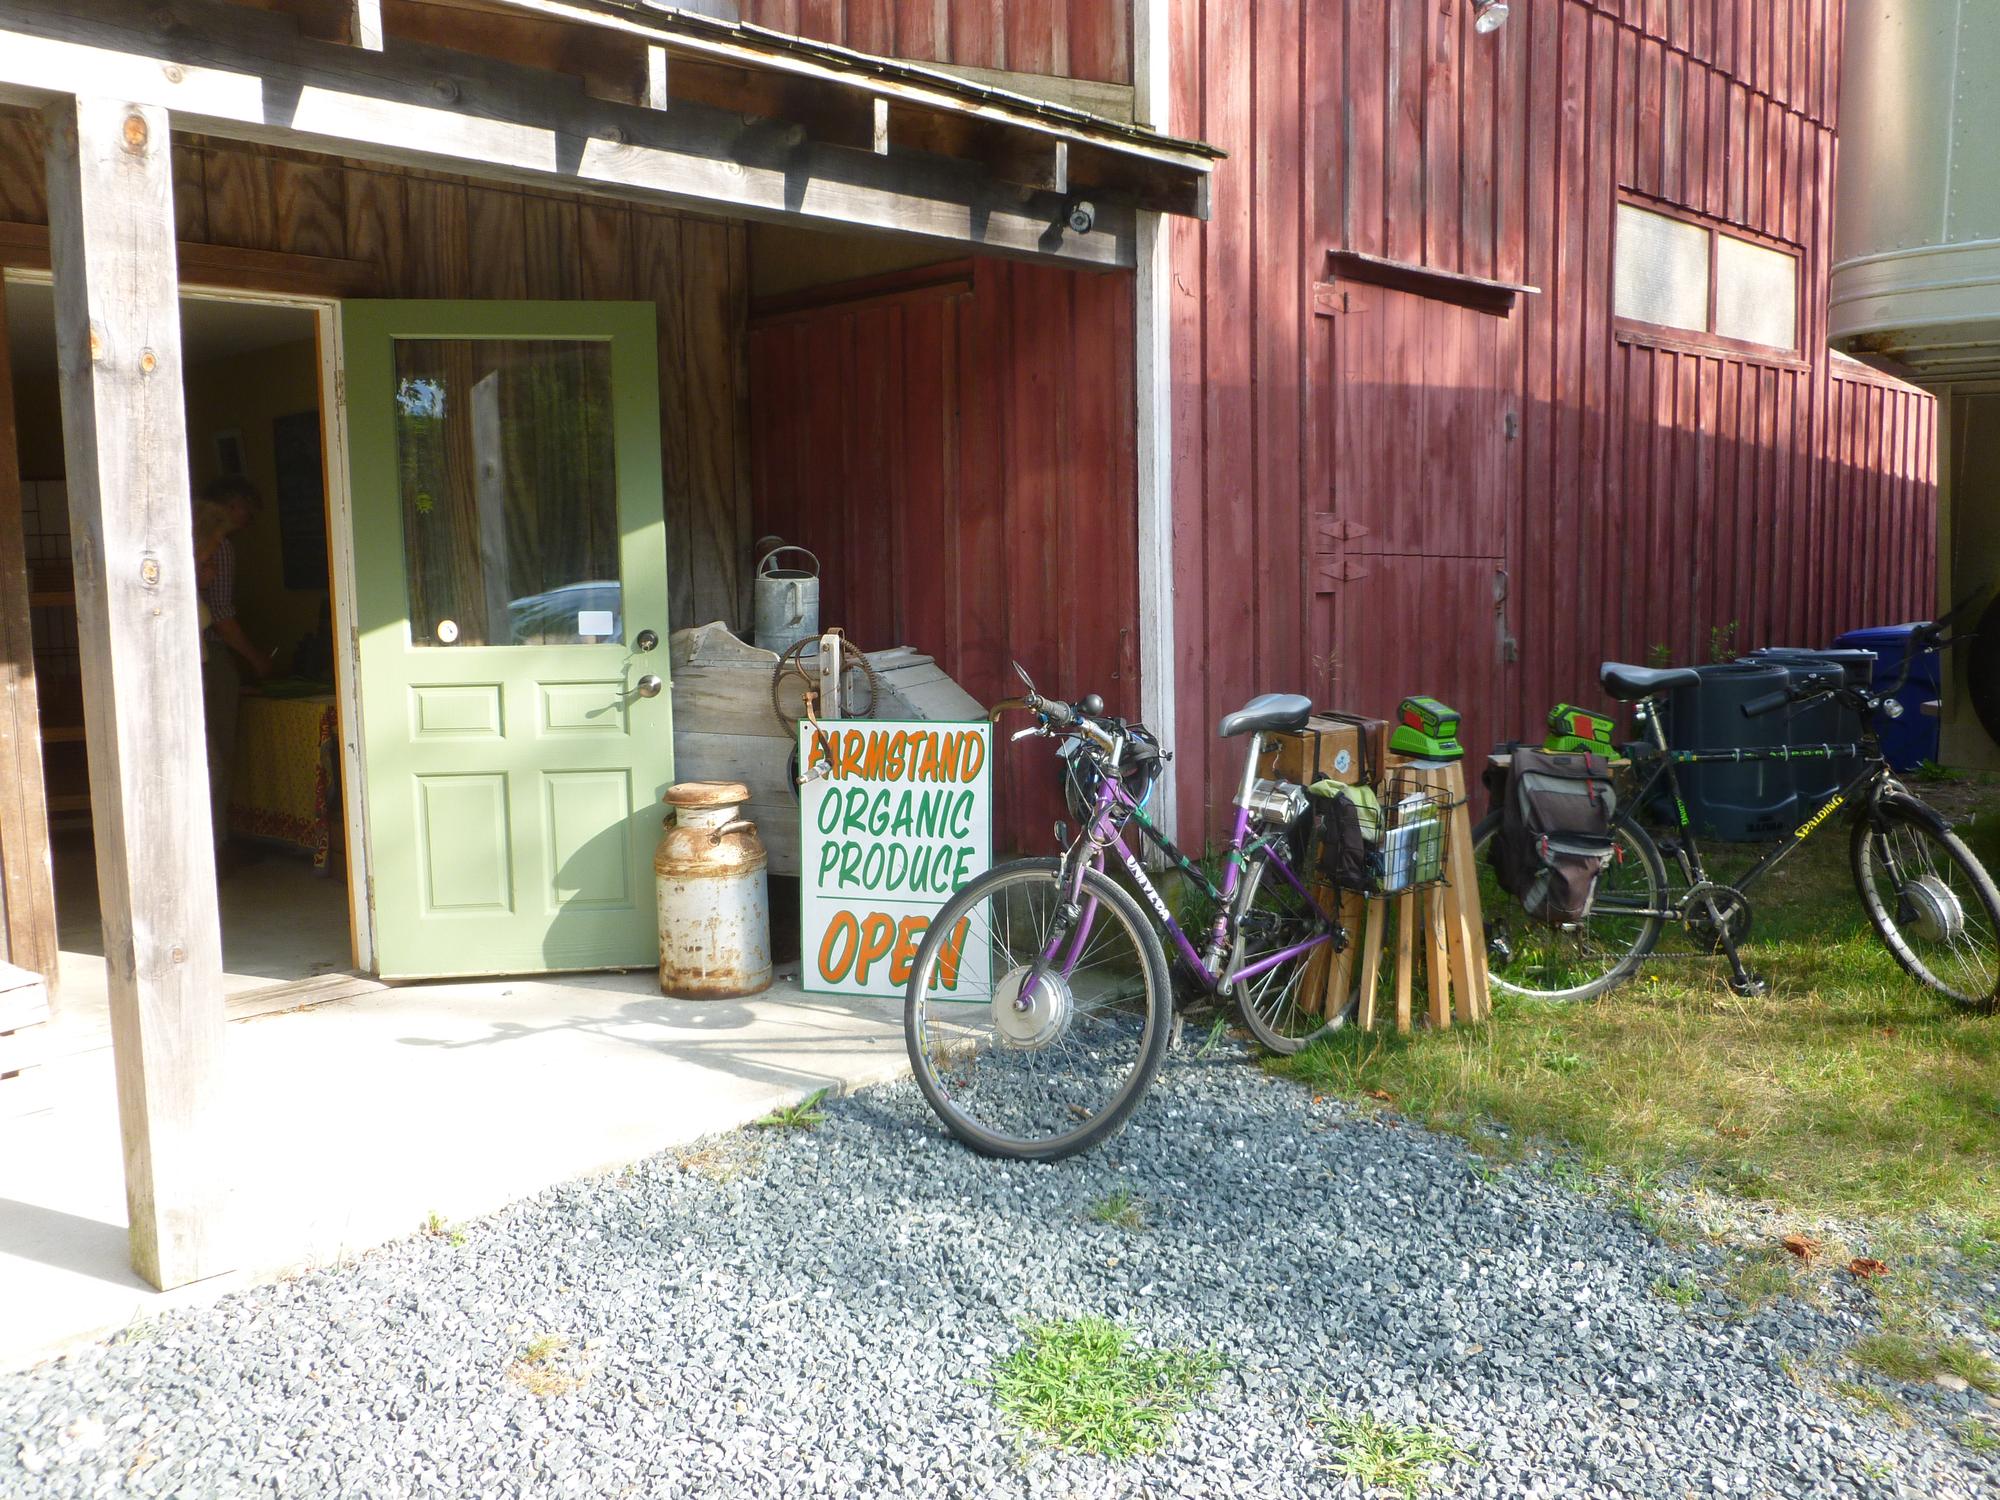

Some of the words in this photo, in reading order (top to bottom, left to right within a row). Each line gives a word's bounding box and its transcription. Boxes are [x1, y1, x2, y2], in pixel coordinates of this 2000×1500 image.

[808, 729, 984, 783] FARMSTAND
[817, 787, 975, 839] ORGANIC
[1794, 793, 1844, 838] SPALDING
[817, 840, 976, 893] PRODUCE
[817, 910, 972, 991] OPEN
